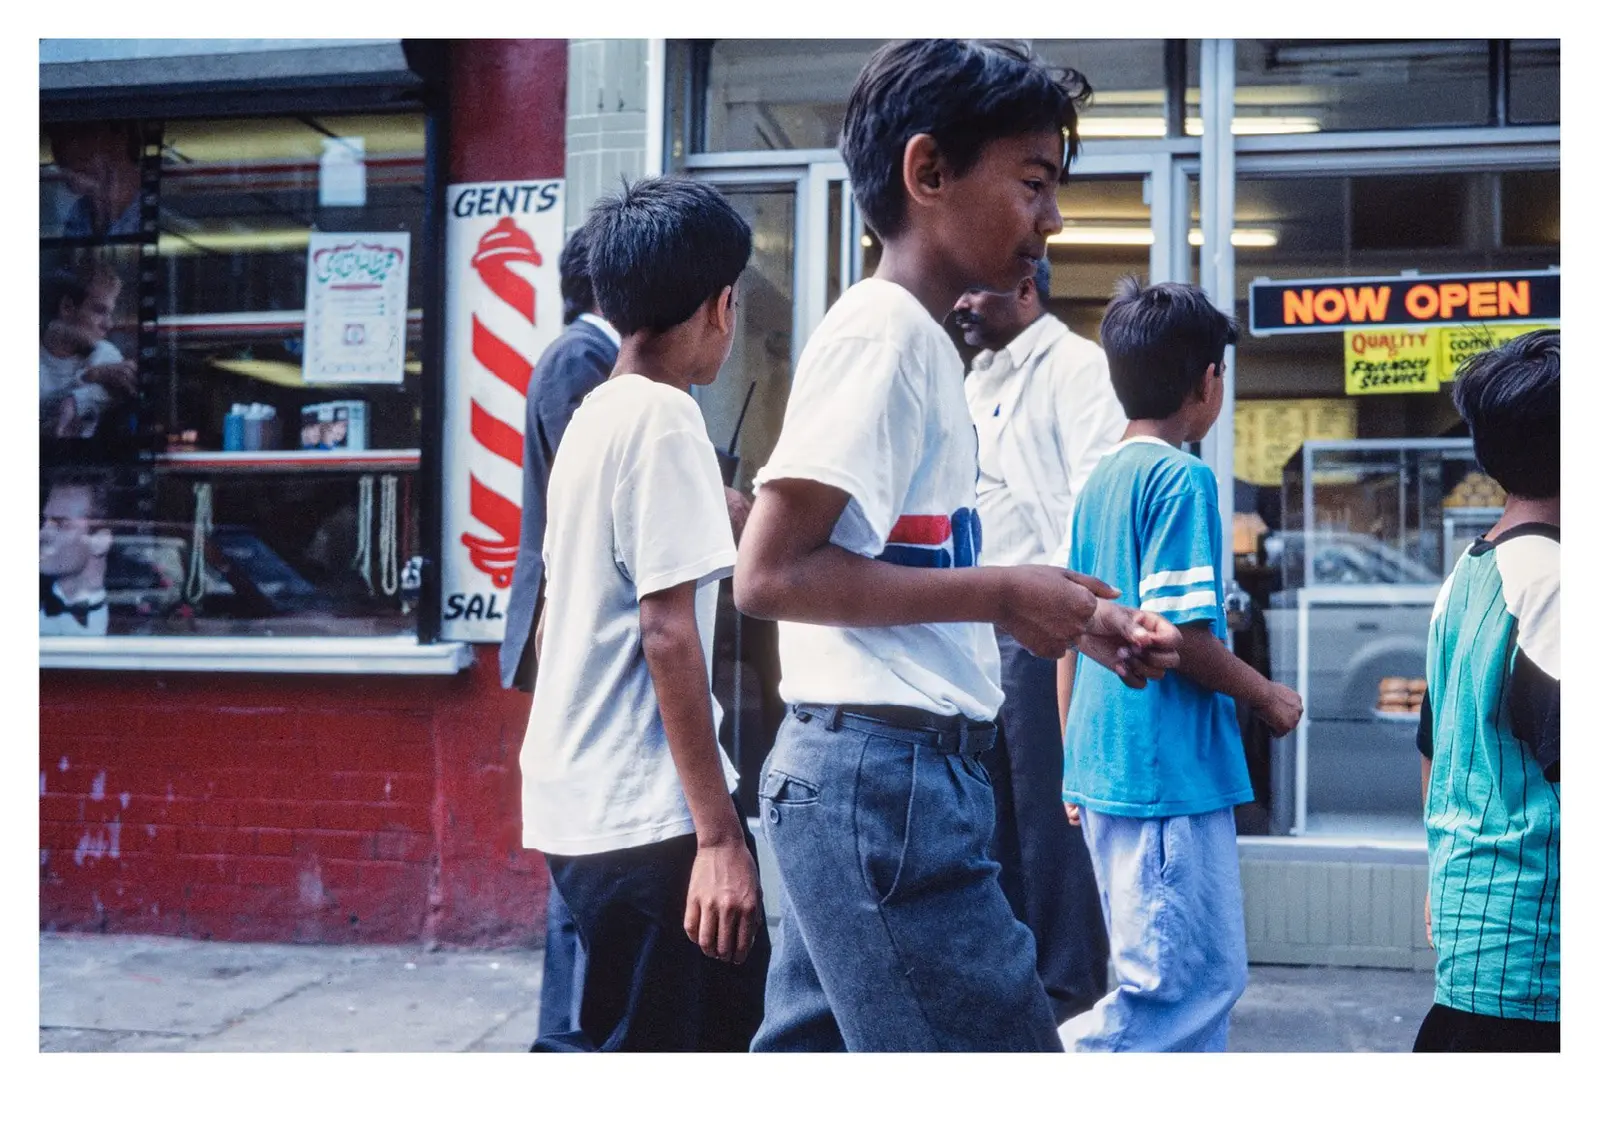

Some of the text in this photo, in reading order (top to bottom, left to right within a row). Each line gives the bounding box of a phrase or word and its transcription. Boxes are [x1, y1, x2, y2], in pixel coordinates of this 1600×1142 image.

[453, 183, 560, 218] GENTS
[1282, 280, 1531, 325] NOW OPEN
[1351, 332, 1428, 355] QUALITY
[1351, 358, 1430, 375] FRIENDLY
[1359, 370, 1426, 390] SERVICE
